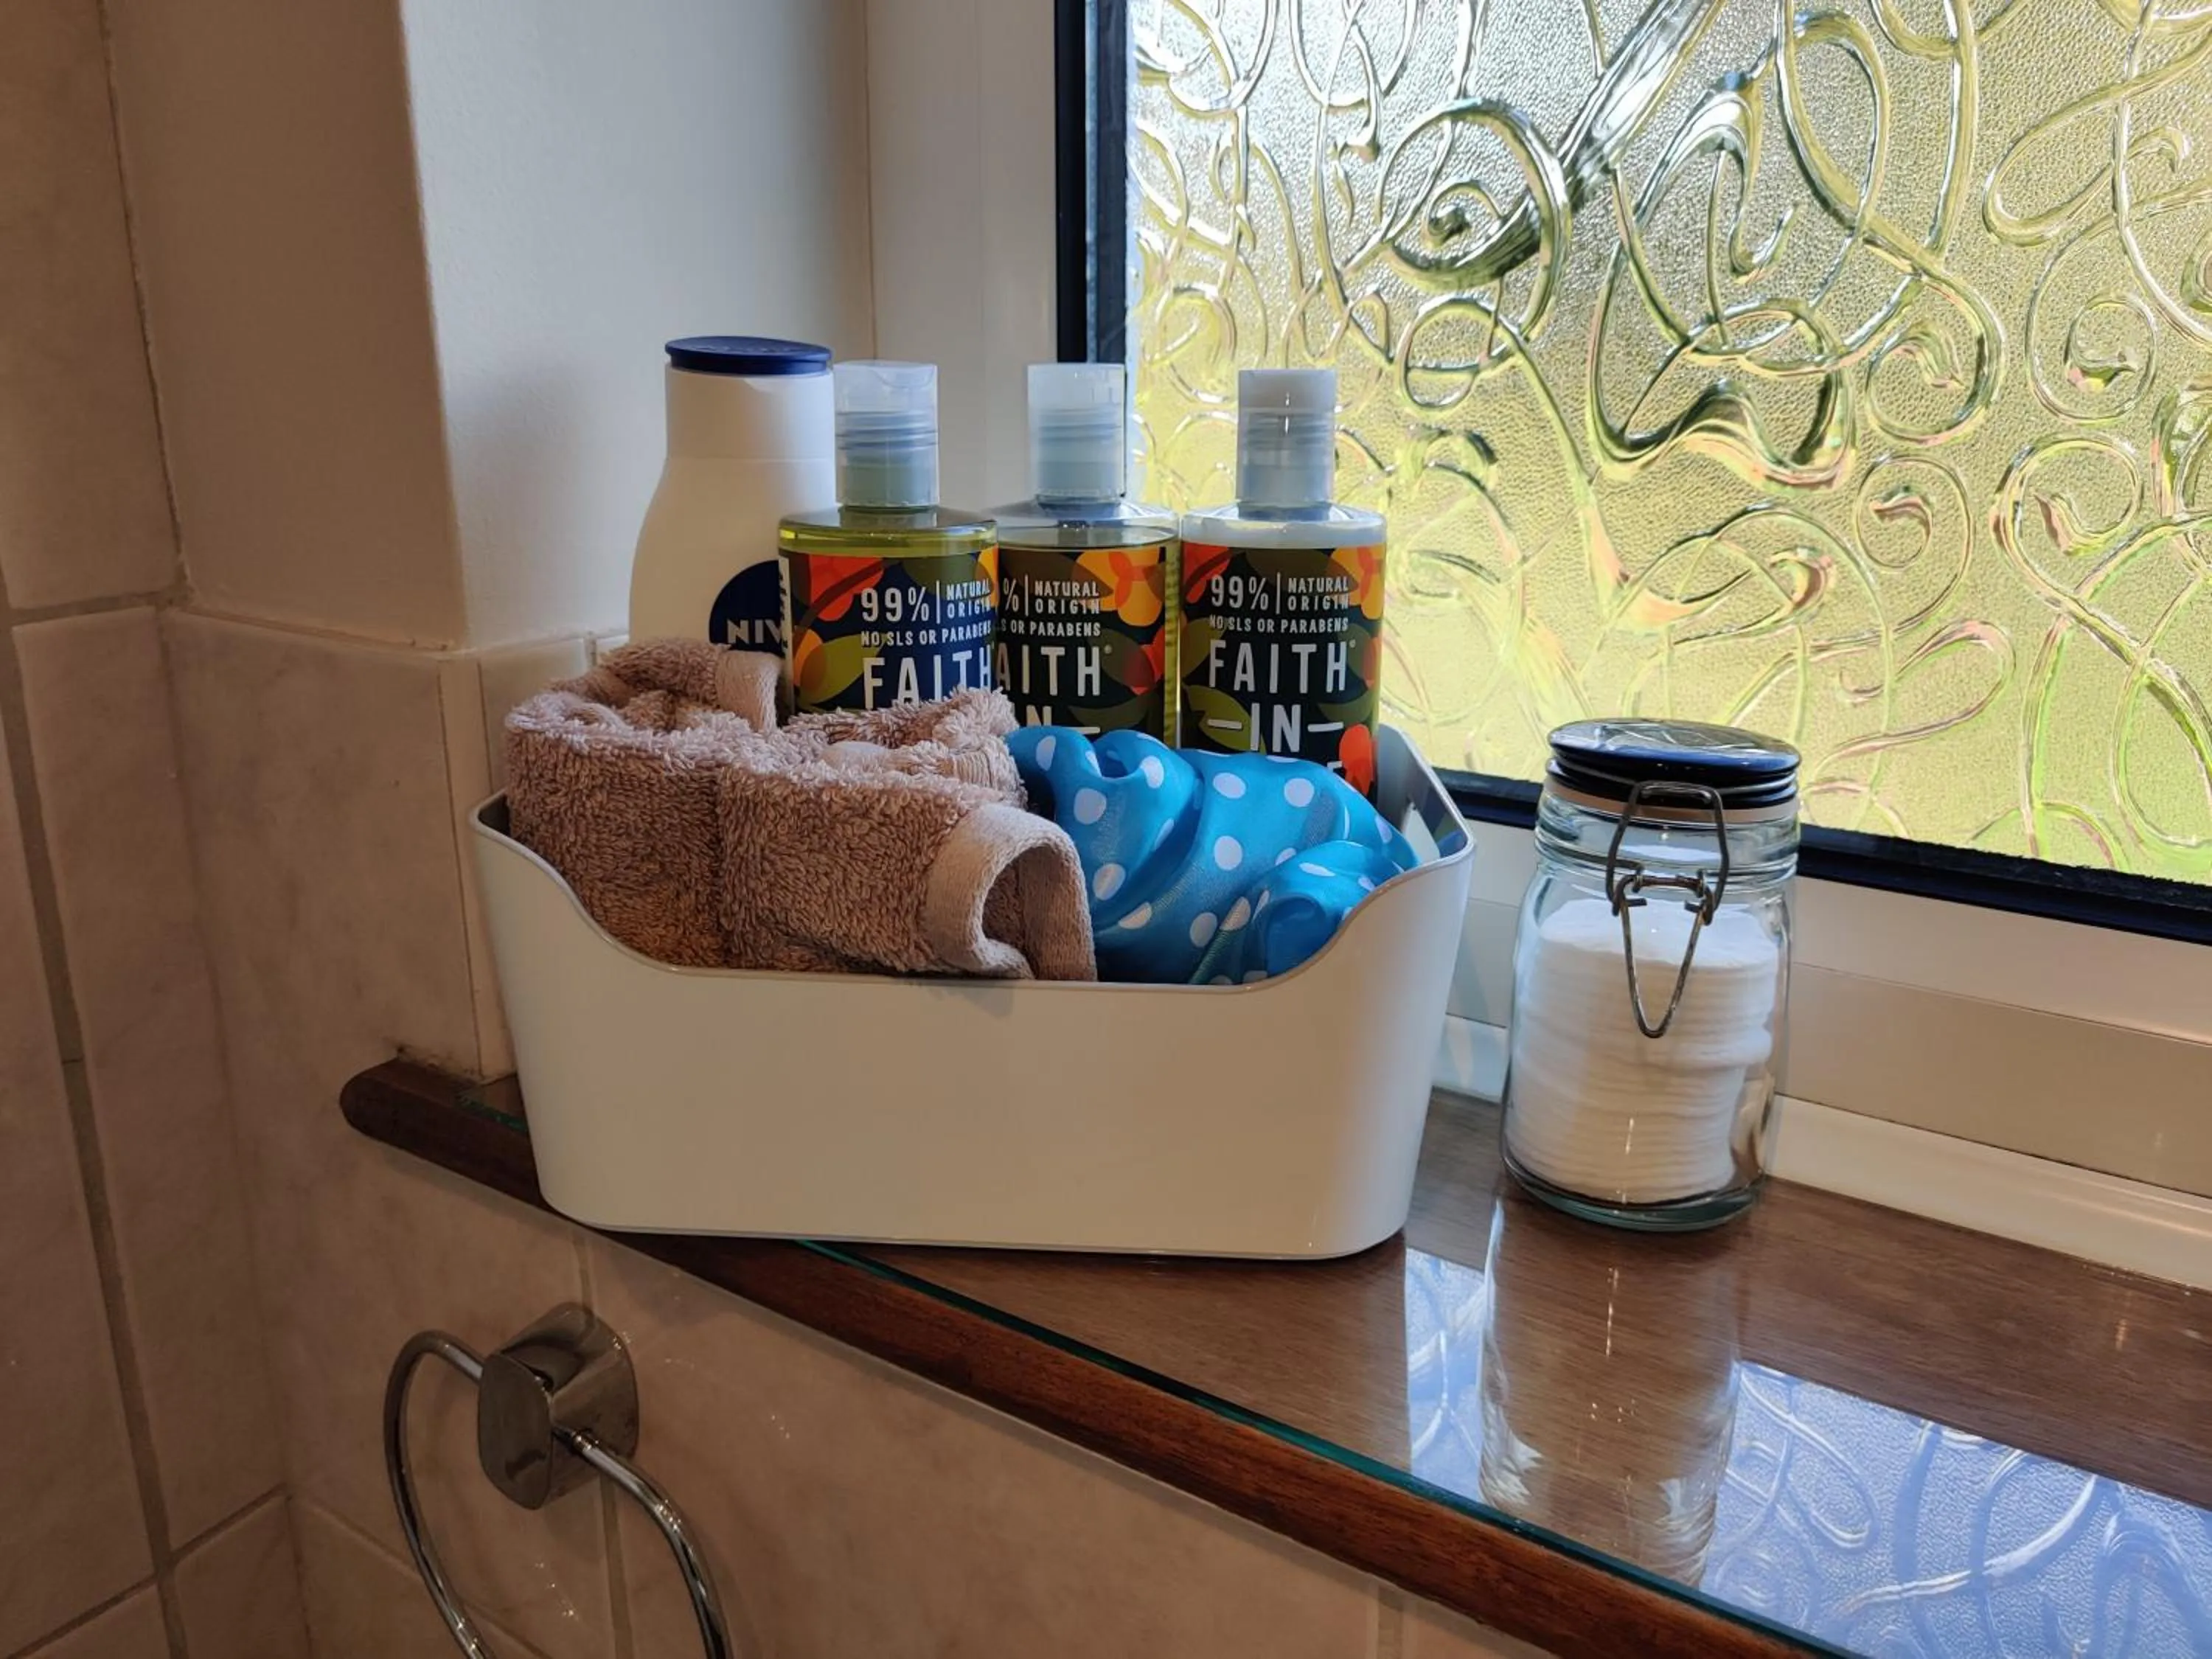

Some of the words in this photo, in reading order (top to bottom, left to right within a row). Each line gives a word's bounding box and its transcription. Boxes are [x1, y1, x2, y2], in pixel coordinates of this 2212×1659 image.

[1034, 581, 1099, 597] NATURAL
[1211, 574, 1269, 611] 99%
[1287, 577, 1349, 591] NATURAL
[860, 587, 930, 622] 99%
[1034, 598, 1099, 614] ORIGIN
[1287, 592, 1349, 611] ORIGIN
[727, 619, 782, 644] NIV
[861, 630, 880, 647] NO
[886, 630, 914, 647] SLS
[919, 627, 936, 645] OR
[942, 619, 992, 643] PARABENS
[1010, 619, 1025, 633] OR
[1030, 622, 1101, 637] PARABENS
[1209, 615, 1224, 629] NO
[1229, 616, 1252, 632] SLS
[1257, 618, 1275, 633] OR
[1281, 617, 1349, 633] PARABENS
[862, 644, 992, 709] FAITH
[996, 642, 1100, 697] AITH
[1208, 639, 1346, 694] FAITH
